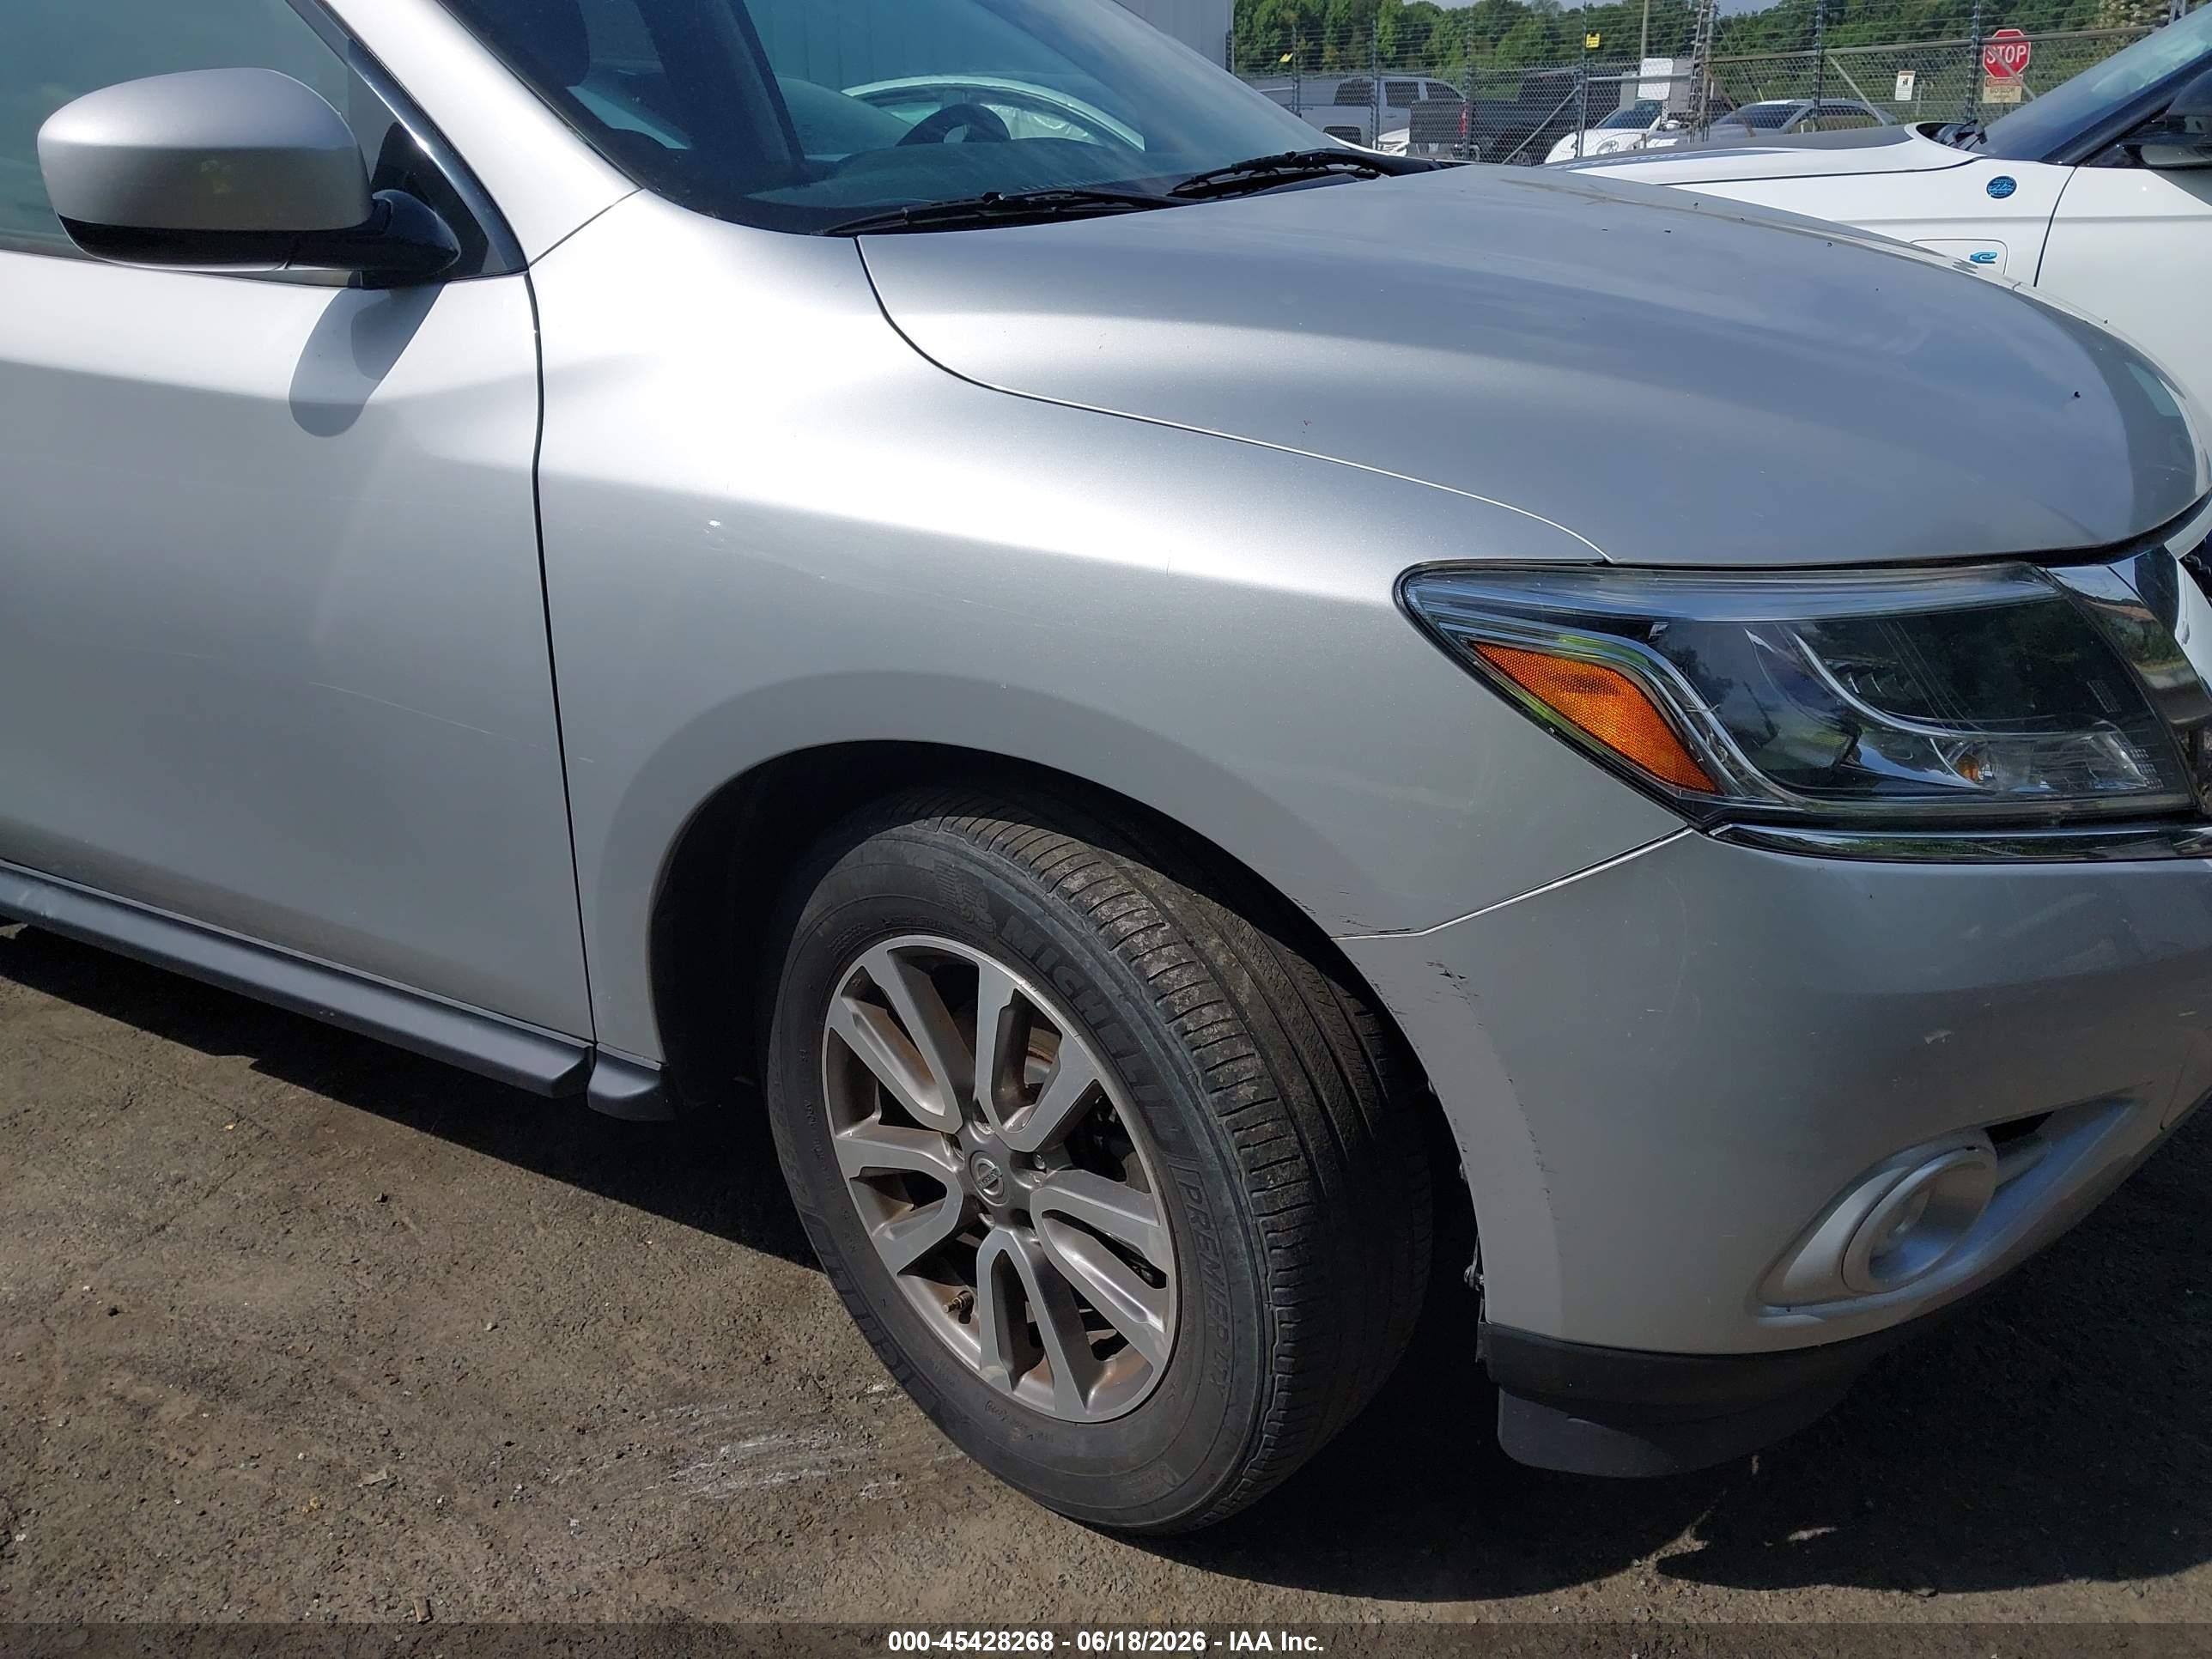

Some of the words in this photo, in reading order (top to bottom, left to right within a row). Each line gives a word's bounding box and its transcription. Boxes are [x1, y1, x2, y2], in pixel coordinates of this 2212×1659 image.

[1986, 45, 2027, 64] STOP
[1000, 915, 1188, 1147] MICHELIN
[1177, 1178, 1231, 1344] PREMIER
